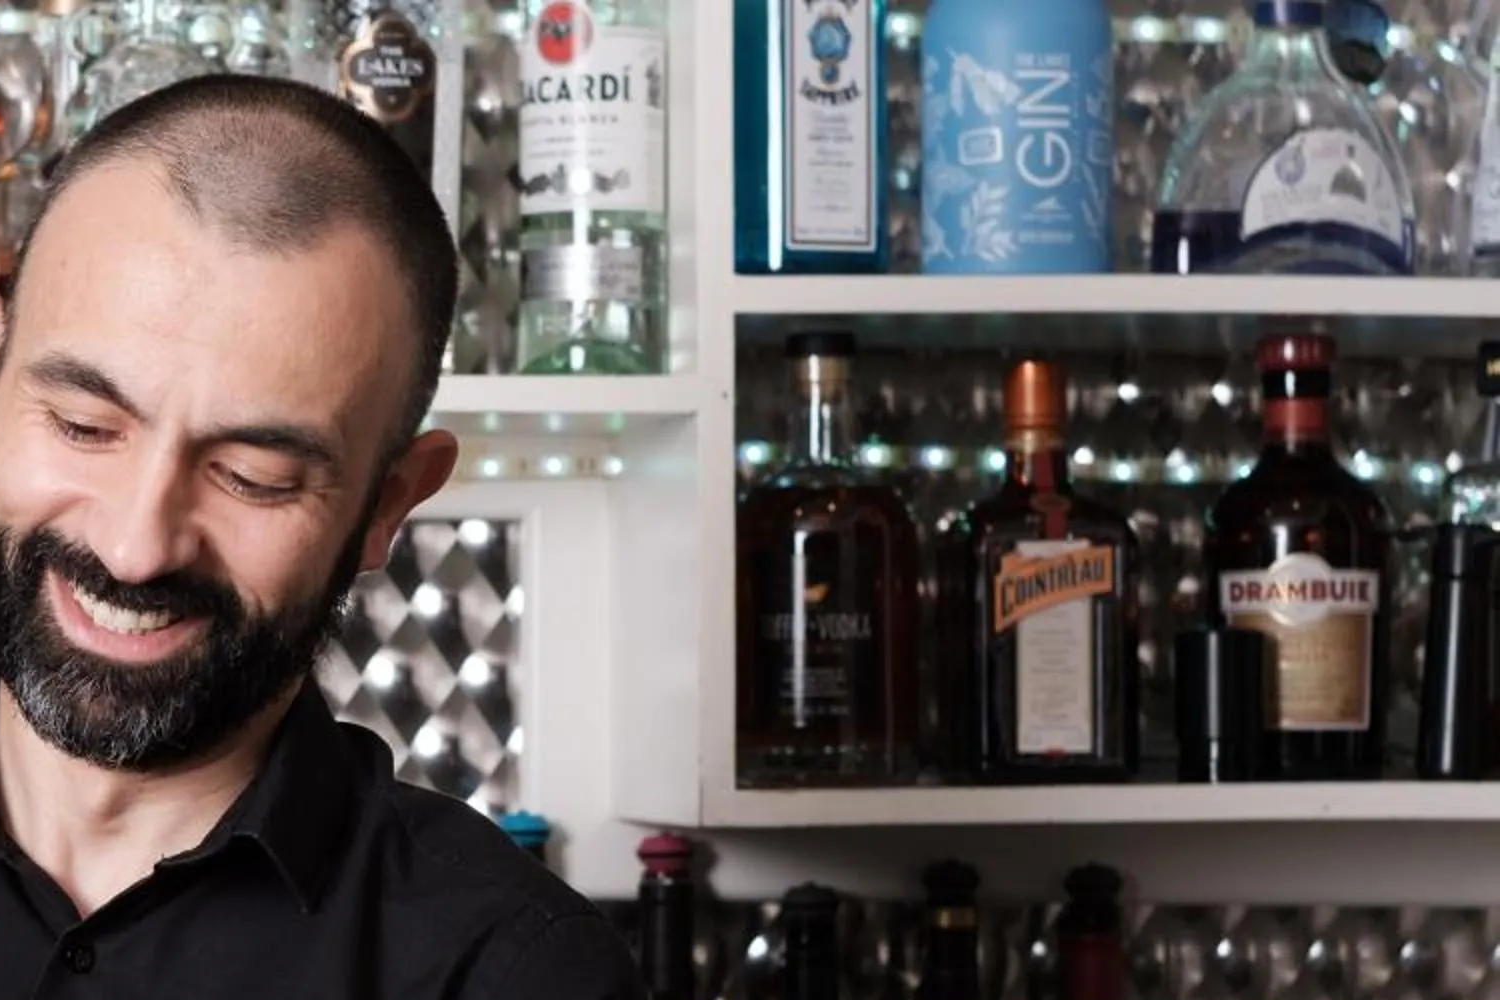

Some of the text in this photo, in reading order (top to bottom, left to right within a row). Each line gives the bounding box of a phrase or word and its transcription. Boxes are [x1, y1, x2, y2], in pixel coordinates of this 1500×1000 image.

[357, 57, 424, 76] LAKES
[1014, 69, 1072, 188] GIN
[1001, 556, 1104, 619] COINTREAU
[1229, 580, 1370, 603] DRAMBUIE
